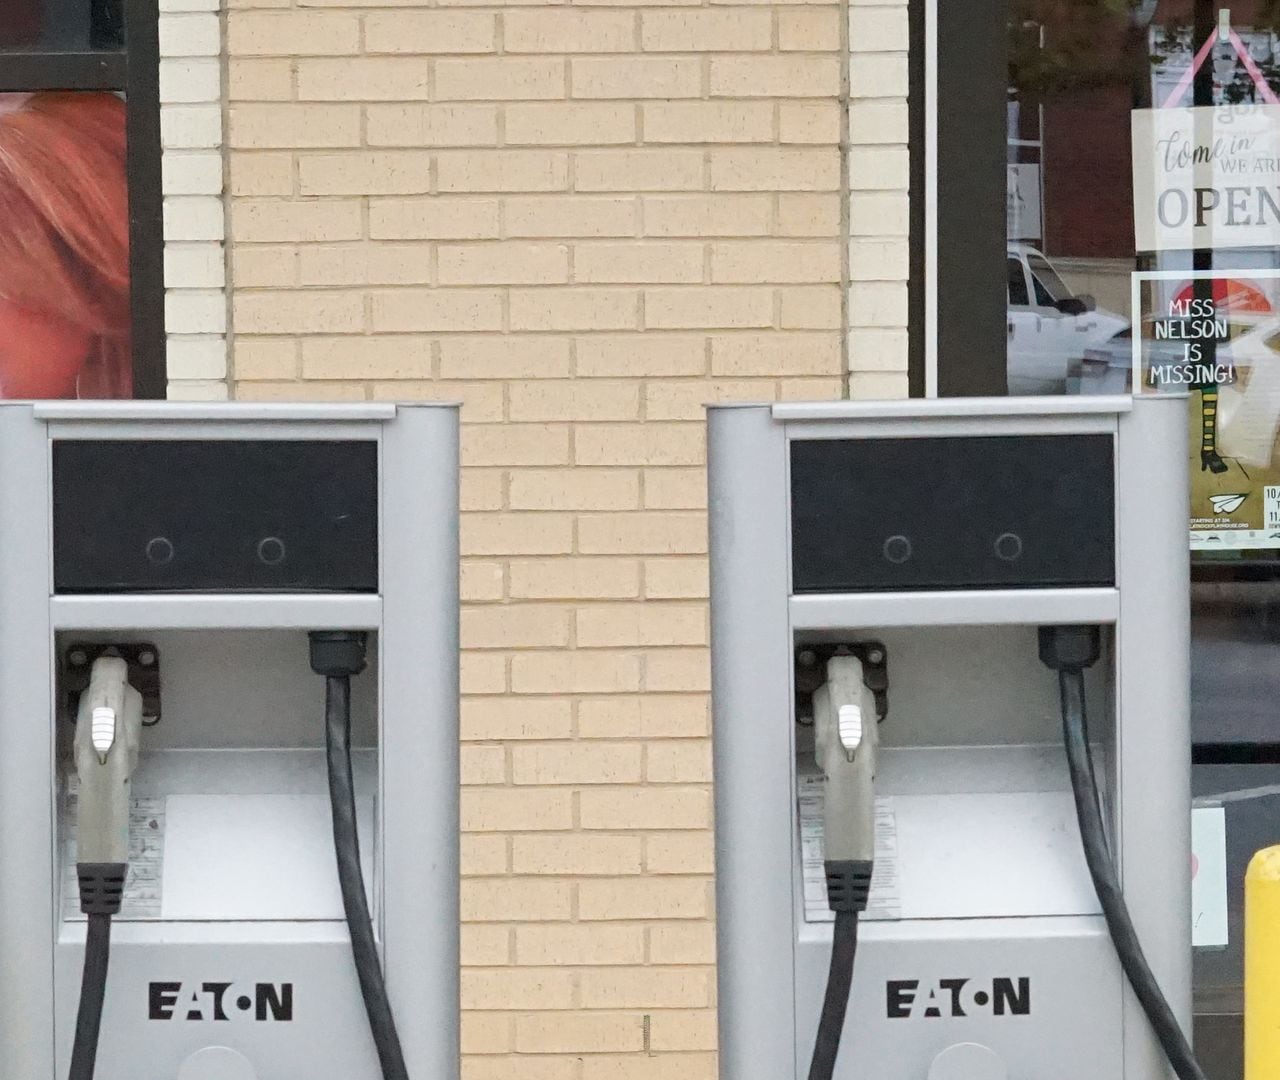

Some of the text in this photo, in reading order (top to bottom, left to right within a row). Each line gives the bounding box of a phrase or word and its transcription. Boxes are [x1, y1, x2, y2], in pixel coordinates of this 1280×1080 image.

[1157, 131, 1253, 172] Come in
[1221, 159, 1247, 173] WE
[1169, 299, 1214, 317] MISS
[1155, 319, 1227, 339] NELSON
[1182, 343, 1202, 362] IS
[1150, 363, 1233, 384] MISSING!
[148, 982, 292, 1021] EATON
[886, 977, 1030, 1018] EATON
